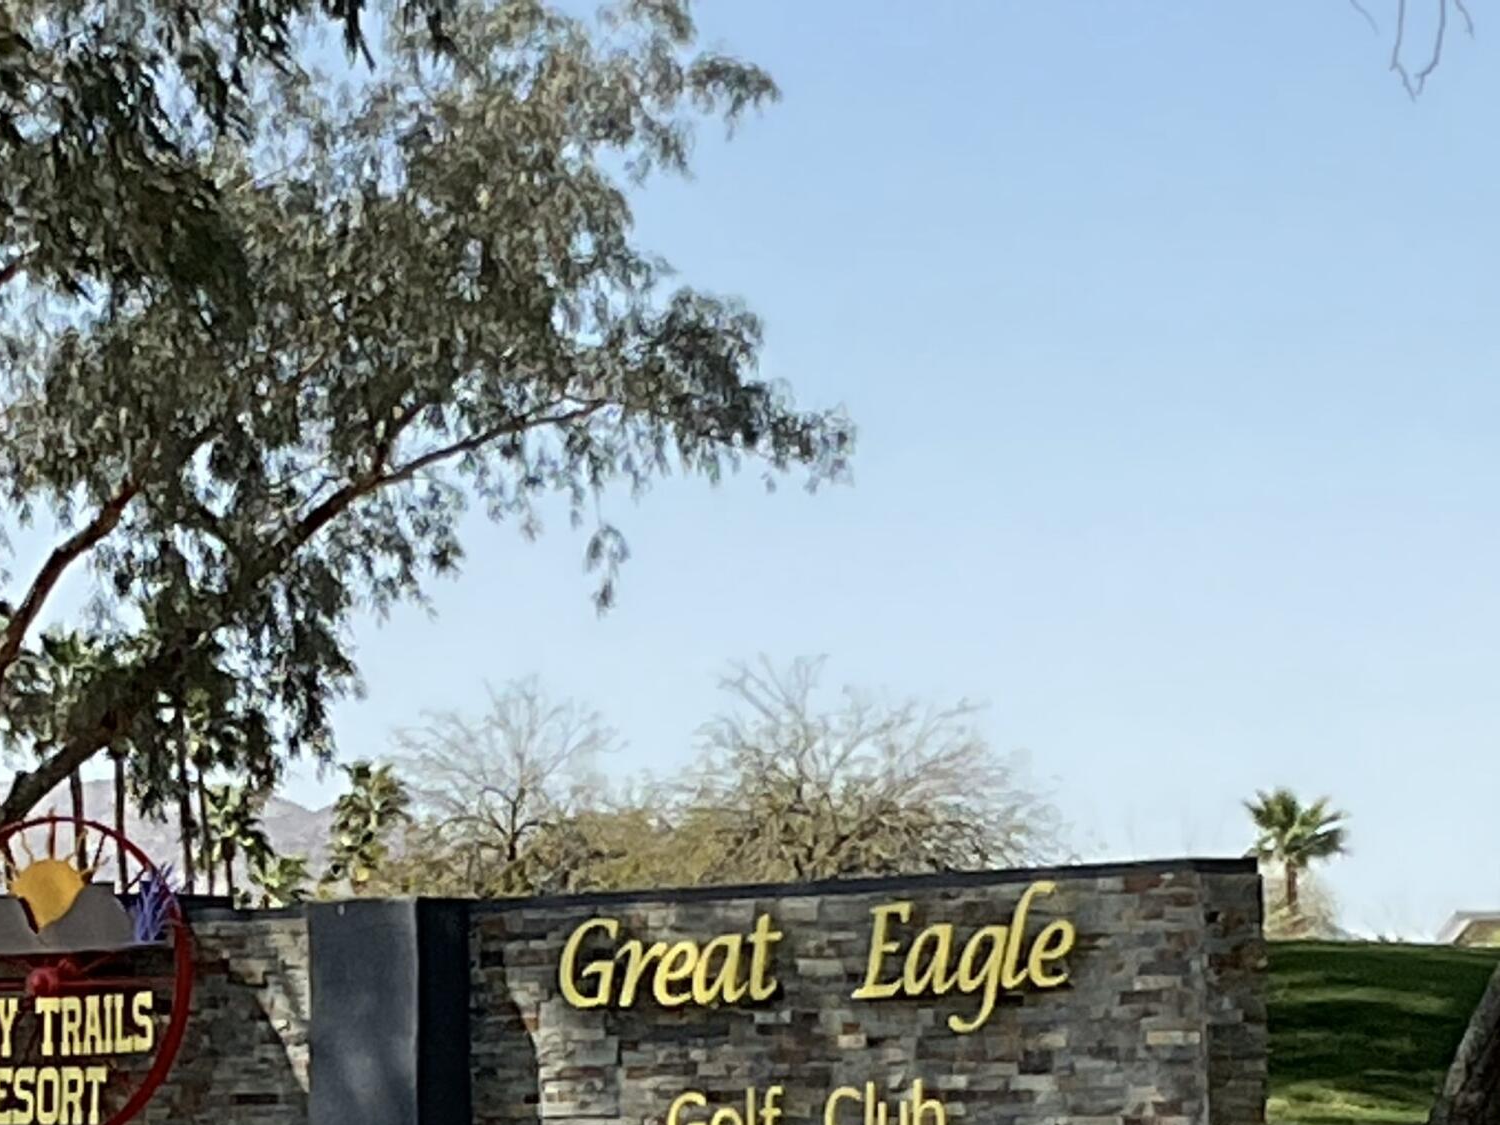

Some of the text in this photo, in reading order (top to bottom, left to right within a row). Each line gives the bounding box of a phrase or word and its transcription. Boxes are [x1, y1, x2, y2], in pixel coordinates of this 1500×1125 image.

[558, 880, 1076, 1034] Great Eagle
[35, 991, 155, 1056] TRAILS
